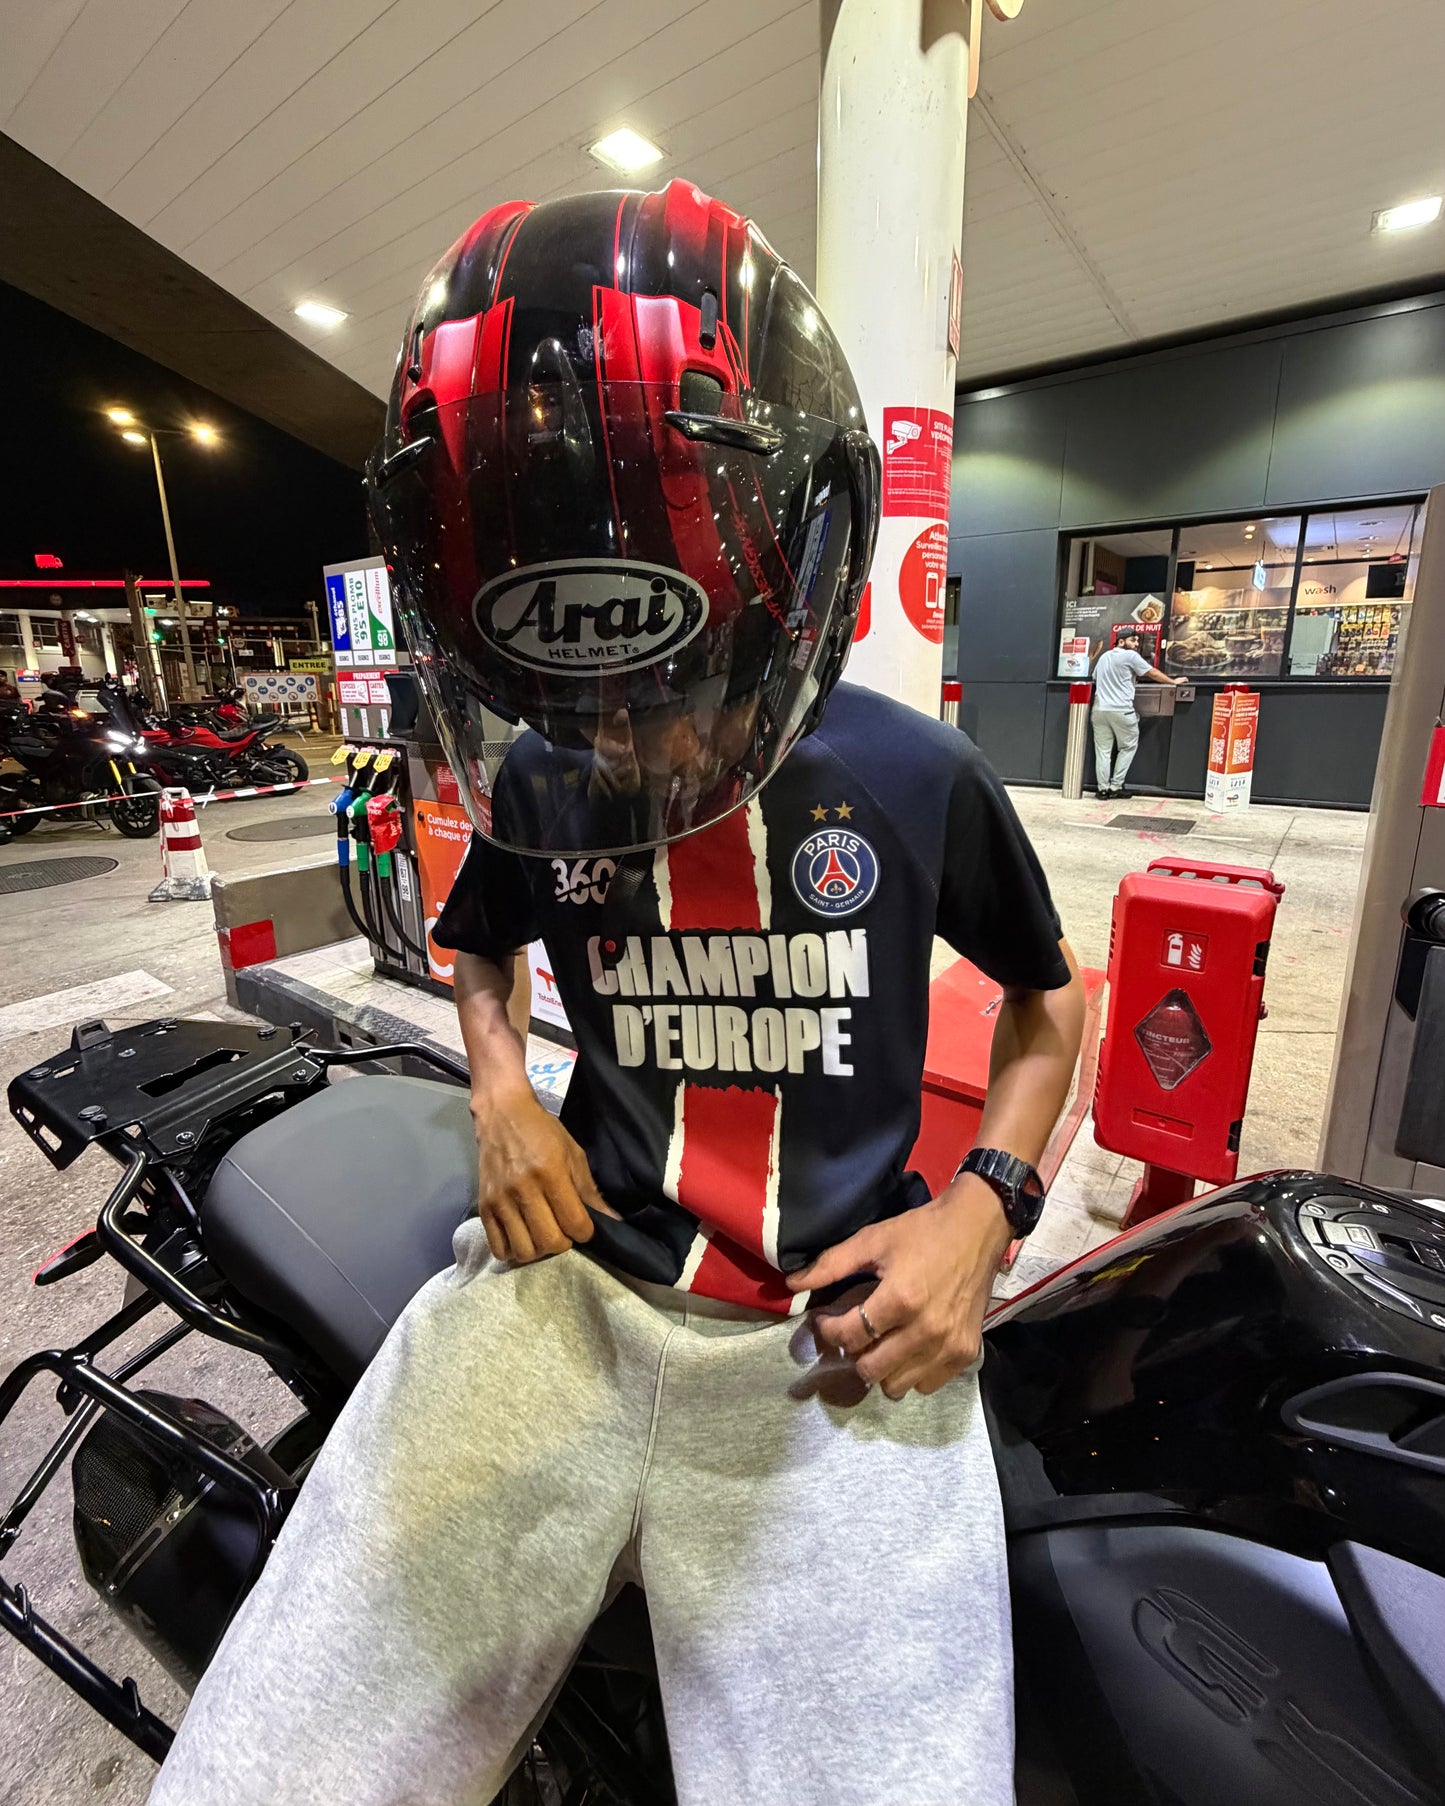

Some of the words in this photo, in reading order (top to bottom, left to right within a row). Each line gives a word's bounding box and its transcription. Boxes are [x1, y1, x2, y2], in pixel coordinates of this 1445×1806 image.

[349, 578, 357, 614] PLOMB
[1304, 584, 1337, 595] wash
[493, 576, 676, 643] Arai
[1066, 600, 1077, 608] ICI
[352, 617, 361, 645] SANS
[1135, 624, 1145, 632] DE
[1145, 623, 1162, 632] NUIT
[377, 633, 389, 646] 98
[427, 813, 458, 829] Cumulez
[428, 826, 434, 836] à
[434, 827, 461, 841] chaque
[803, 833, 860, 857] PARIS
[586, 928, 870, 998] CHAMPION
[611, 1004, 855, 1077] D'EUROPE
